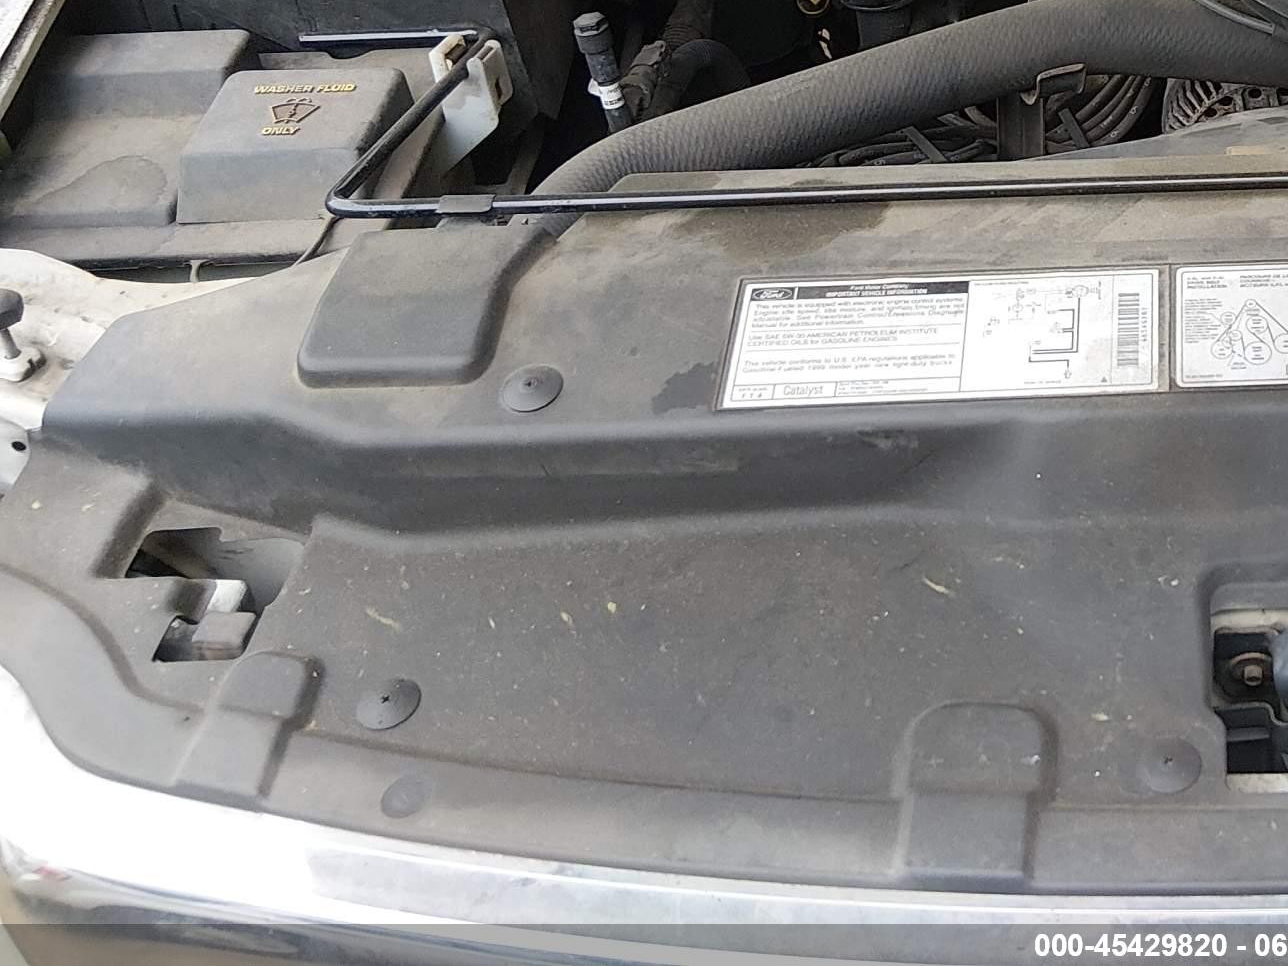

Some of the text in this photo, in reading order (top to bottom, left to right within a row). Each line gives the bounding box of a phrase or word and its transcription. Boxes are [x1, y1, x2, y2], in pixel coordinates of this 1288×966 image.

[254, 84, 357, 94] WASHER FLUID
[262, 126, 300, 136] ONLY
[782, 383, 824, 396] Catalyst
